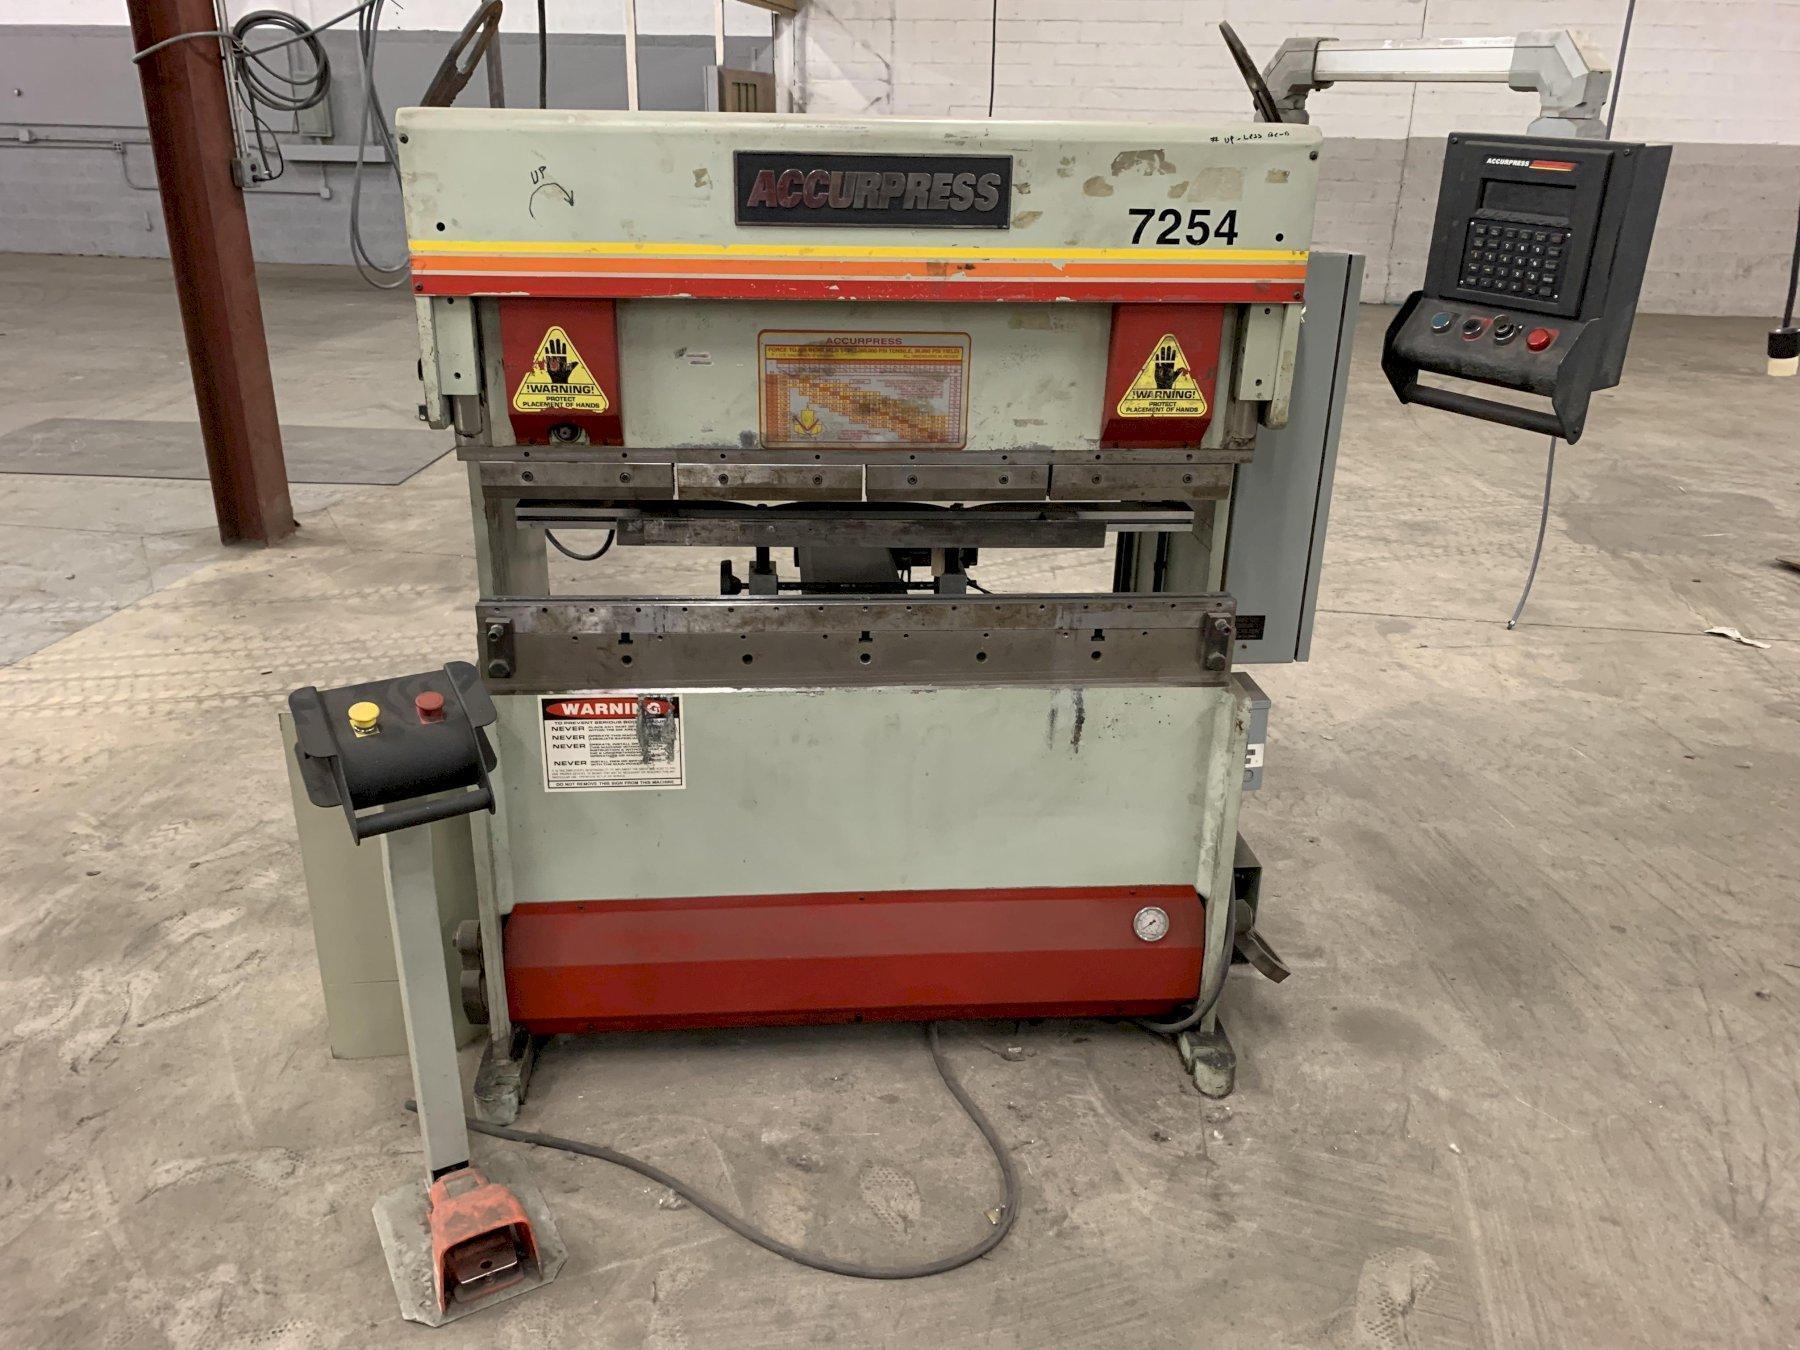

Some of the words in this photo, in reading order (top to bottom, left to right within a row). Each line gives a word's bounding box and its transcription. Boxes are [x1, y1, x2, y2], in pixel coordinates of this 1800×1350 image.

[1486, 157, 1530, 167] ACCURPRESS
[530, 165, 547, 185] UP
[746, 168, 1001, 212] ACCURPRESS
[1128, 208, 1239, 246] 7254
[825, 337, 903, 345] ACCURPRESS
